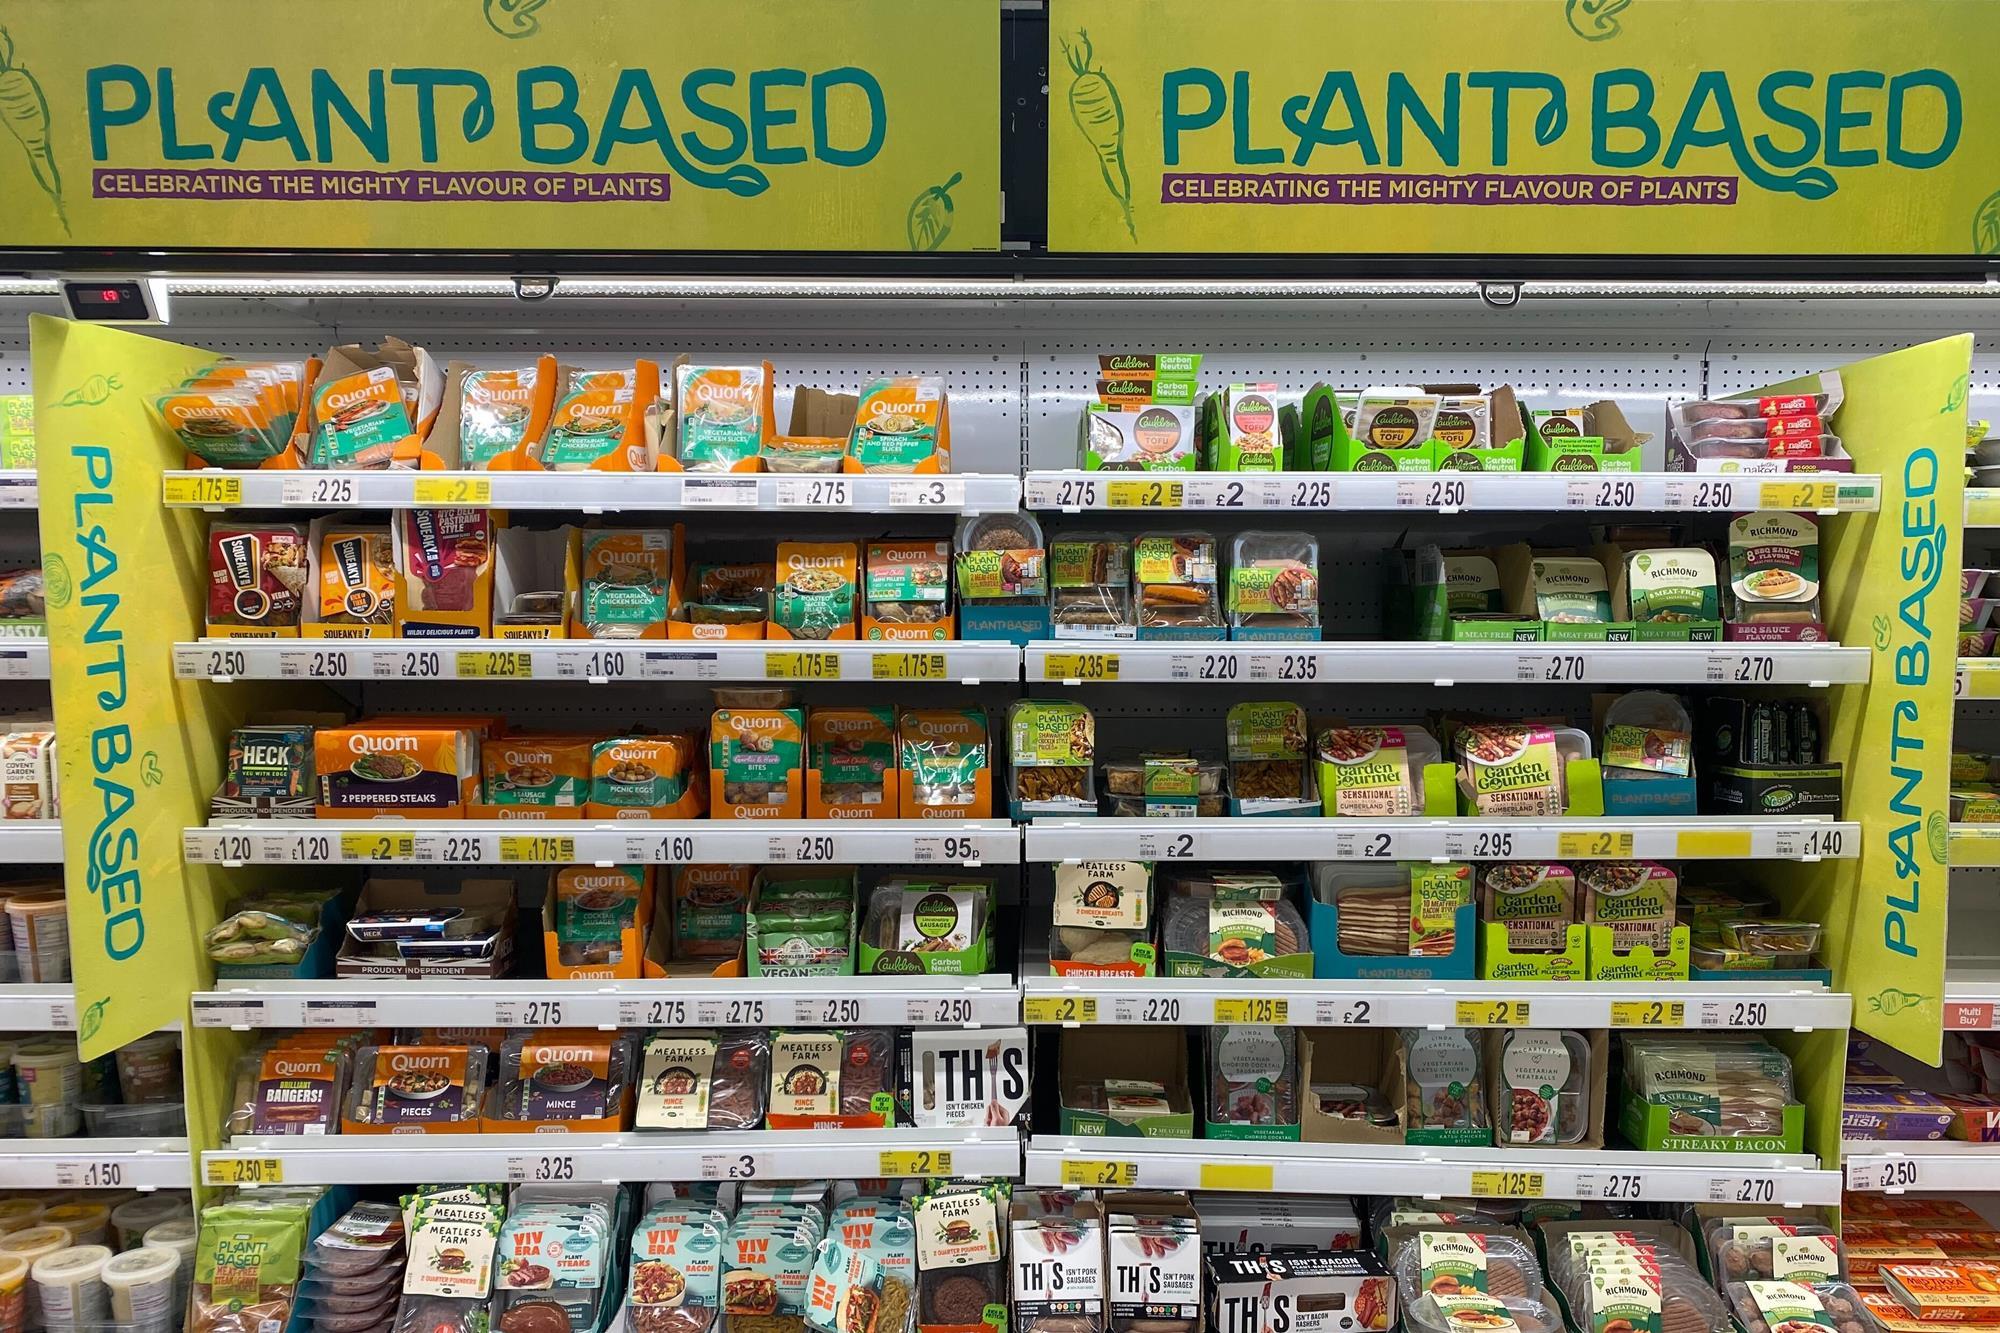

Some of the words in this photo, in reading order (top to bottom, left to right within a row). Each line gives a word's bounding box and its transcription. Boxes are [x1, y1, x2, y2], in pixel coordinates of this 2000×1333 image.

[85, 65, 496, 166] PLANT
[518, 65, 888, 196] BASED
[1162, 68, 1568, 167] PLANT
[1591, 68, 1961, 197] BASED
[99, 174, 262, 196] CELEBRATING
[268, 175, 314, 194] THE
[320, 175, 410, 196] MIGHTY
[417, 176, 527, 197] FLAVOUR
[533, 178, 567, 197] OF
[573, 178, 664, 197] PLANTS
[1168, 178, 1331, 199] CELEBRATING
[1338, 178, 1383, 199] THE
[1388, 178, 1479, 200] MIGHTY
[1485, 179, 1595, 200] FLAVOUR
[1602, 181, 1635, 200] OF
[1640, 181, 1730, 201] PLANTS
[1110, 356, 1150, 371] Cauldron
[1161, 356, 1192, 364] Carbon
[1161, 362, 1192, 370] Neutral
[327, 383, 385, 409] Quorn
[697, 384, 751, 402] Quorn
[570, 403, 622, 418] Quorn
[871, 401, 926, 414] Quorn
[1375, 414, 1415, 426] Cauldron
[1380, 433, 1404, 441] TOFU
[193, 479, 222, 501] £1.75
[447, 482, 467, 501] £2
[919, 482, 945, 504] £3
[1057, 482, 1094, 505] £2.75
[1142, 483, 1162, 505] £2
[1216, 482, 1244, 506] £2
[1291, 482, 1330, 506] £2.25
[1426, 482, 1464, 505] £2.50
[1596, 483, 1634, 506] £2.50
[1693, 484, 1731, 507] £2.50
[1793, 484, 1813, 507] £2
[439, 515, 480, 527] PASTRAMI
[440, 524, 463, 534] STYLE
[1751, 528, 1798, 537] RICHMOND
[231, 540, 250, 581] SQUEAKY
[789, 554, 844, 570] Quorn
[969, 564, 998, 573] BASED
[970, 556, 998, 565] PLANT
[1895, 447, 1945, 687] BASED
[71, 446, 127, 712] PLANT
[1651, 568, 1697, 578] RICHMOND
[694, 626, 724, 636] Quorn
[885, 628, 928, 641] Quorn
[207, 651, 245, 677] £2.50
[310, 652, 347, 678] £2.50
[403, 652, 440, 678] £2.50
[586, 652, 623, 675] £1.60
[793, 654, 821, 676] £1.75
[899, 655, 927, 676] £1.75
[1075, 655, 1102, 677] £2.35
[1200, 655, 1237, 678] £2.20
[1279, 656, 1316, 678] £2.35
[1546, 657, 1583, 680] £2.70
[1735, 657, 1772, 680] £2.70
[242, 746, 288, 764] HECK
[349, 734, 418, 754] Quorn
[610, 748, 657, 760] Quorn
[1484, 762, 1546, 776] Garden
[1478, 772, 1550, 789] Gourmet
[349, 794, 397, 802] PEPPERED
[400, 794, 436, 802] STEAKS
[1491, 792, 1543, 802] SENSATIONAL
[1884, 701, 1924, 959] PLANT
[87, 724, 144, 961] BASED
[214, 837, 250, 860] £1.20
[292, 837, 328, 860] £1.20
[372, 838, 391, 860] £2
[444, 838, 480, 861] £2.25
[529, 838, 556, 860] £1.75
[656, 838, 692, 860] £1.60
[797, 838, 833, 860] £2.50
[945, 838, 979, 860] 95p
[1167, 834, 1194, 857] £2
[1365, 834, 1391, 856] £2
[1474, 833, 1512, 856] £2.95
[1592, 832, 1612, 855] £2
[1804, 831, 1842, 854] £1.40
[1077, 862, 1126, 870] MEATLESS
[1088, 870, 1114, 878] FARM
[1222, 909, 1262, 918] RICHMOND
[878, 958, 922, 972] Cauldron
[524, 1002, 561, 1024] £2.75
[648, 1001, 685, 1024] £2.75
[726, 1001, 763, 1023] £2.75
[823, 1000, 859, 1022] £2.50
[935, 1000, 971, 1022] £2.50
[1055, 1000, 1074, 1020] £2
[1143, 999, 1179, 1021] £2.20
[1243, 1000, 1271, 1021] £1.25
[1344, 1001, 1370, 1023] £2
[1488, 1002, 1508, 1024] £2
[1643, 1002, 1663, 1024] £2
[1729, 1002, 1766, 1026] £2.50
[1959, 1007, 1981, 1017] Multi
[1960, 1016, 1978, 1026] Buy
[391, 1055, 449, 1071] Quorn
[536, 1047, 592, 1062] Quorn
[266, 1089, 322, 1102] BANGERS!
[546, 1101, 576, 1109] MINCE
[401, 1108, 431, 1116] PIECES
[1662, 1139, 1733, 1150] STREAKY
[1736, 1140, 1786, 1150] BACON
[233, 1160, 260, 1181] £2.50
[536, 1157, 572, 1179] £3.25
[729, 1156, 754, 1178] £3
[911, 1152, 930, 1173] £2
[1098, 1162, 1117, 1184] £2
[85, 1163, 120, 1186] £1.50
[1498, 1173, 1525, 1195] £1.25
[1881, 1161, 1916, 1187] £2.50
[1604, 1176, 1640, 1198] £2.75
[1737, 1179, 1773, 1201] £2.70
[430, 1226, 482, 1237] MEATLESS
[440, 1235, 467, 1244] FARM
[513, 1232, 543, 1244] VIV
[515, 1244, 540, 1255] ERA
[1067, 1275, 1096, 1284] SAUSAGES
[1605, 1287, 1647, 1297] RICHMOND
